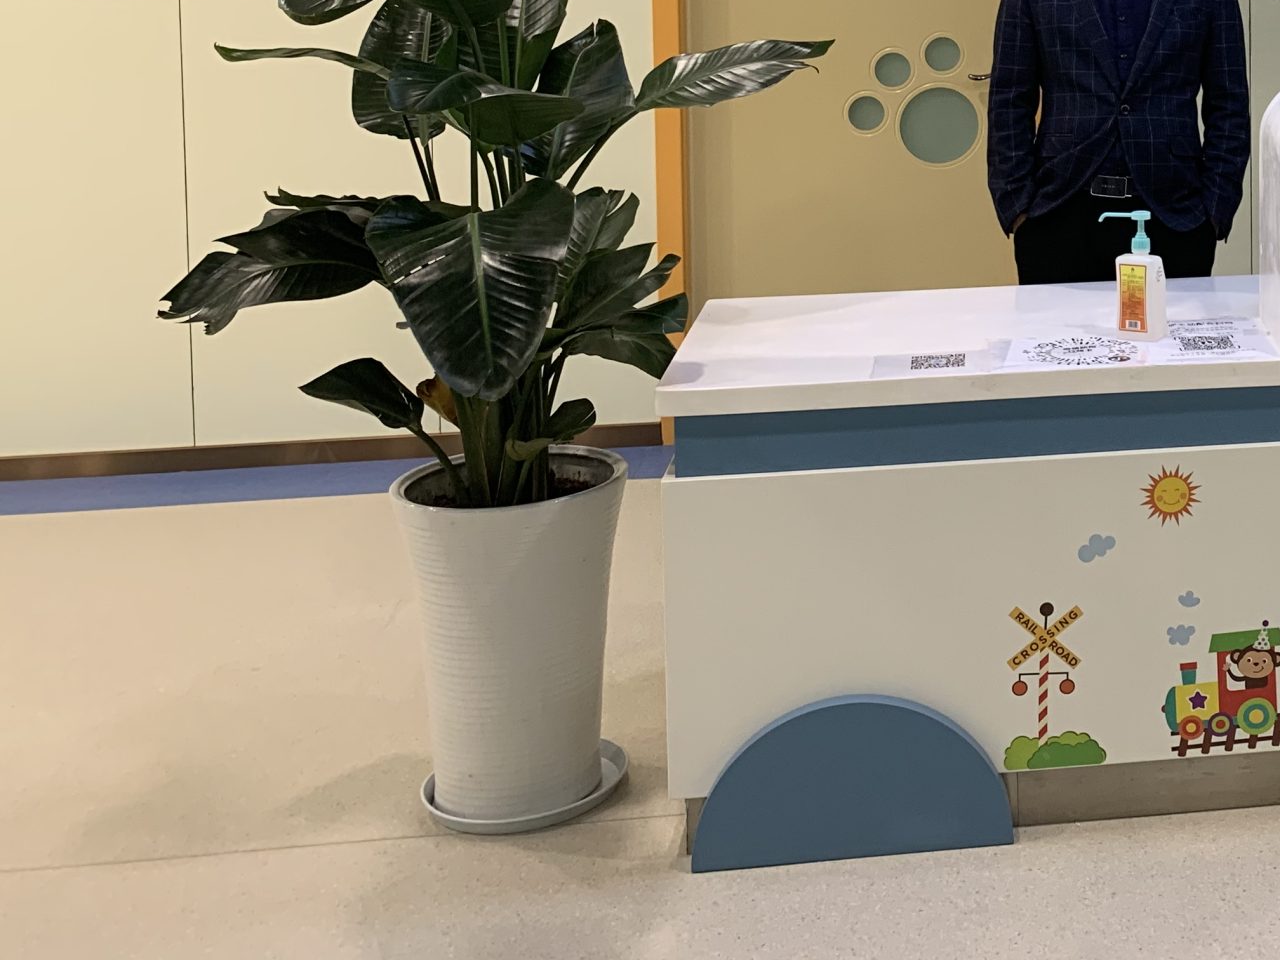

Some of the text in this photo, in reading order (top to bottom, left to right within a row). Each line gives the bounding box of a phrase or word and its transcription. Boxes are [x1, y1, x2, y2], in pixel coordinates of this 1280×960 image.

[1012, 609, 1079, 666] CROSSING
[1015, 611, 1079, 668] RAIL ROAD
